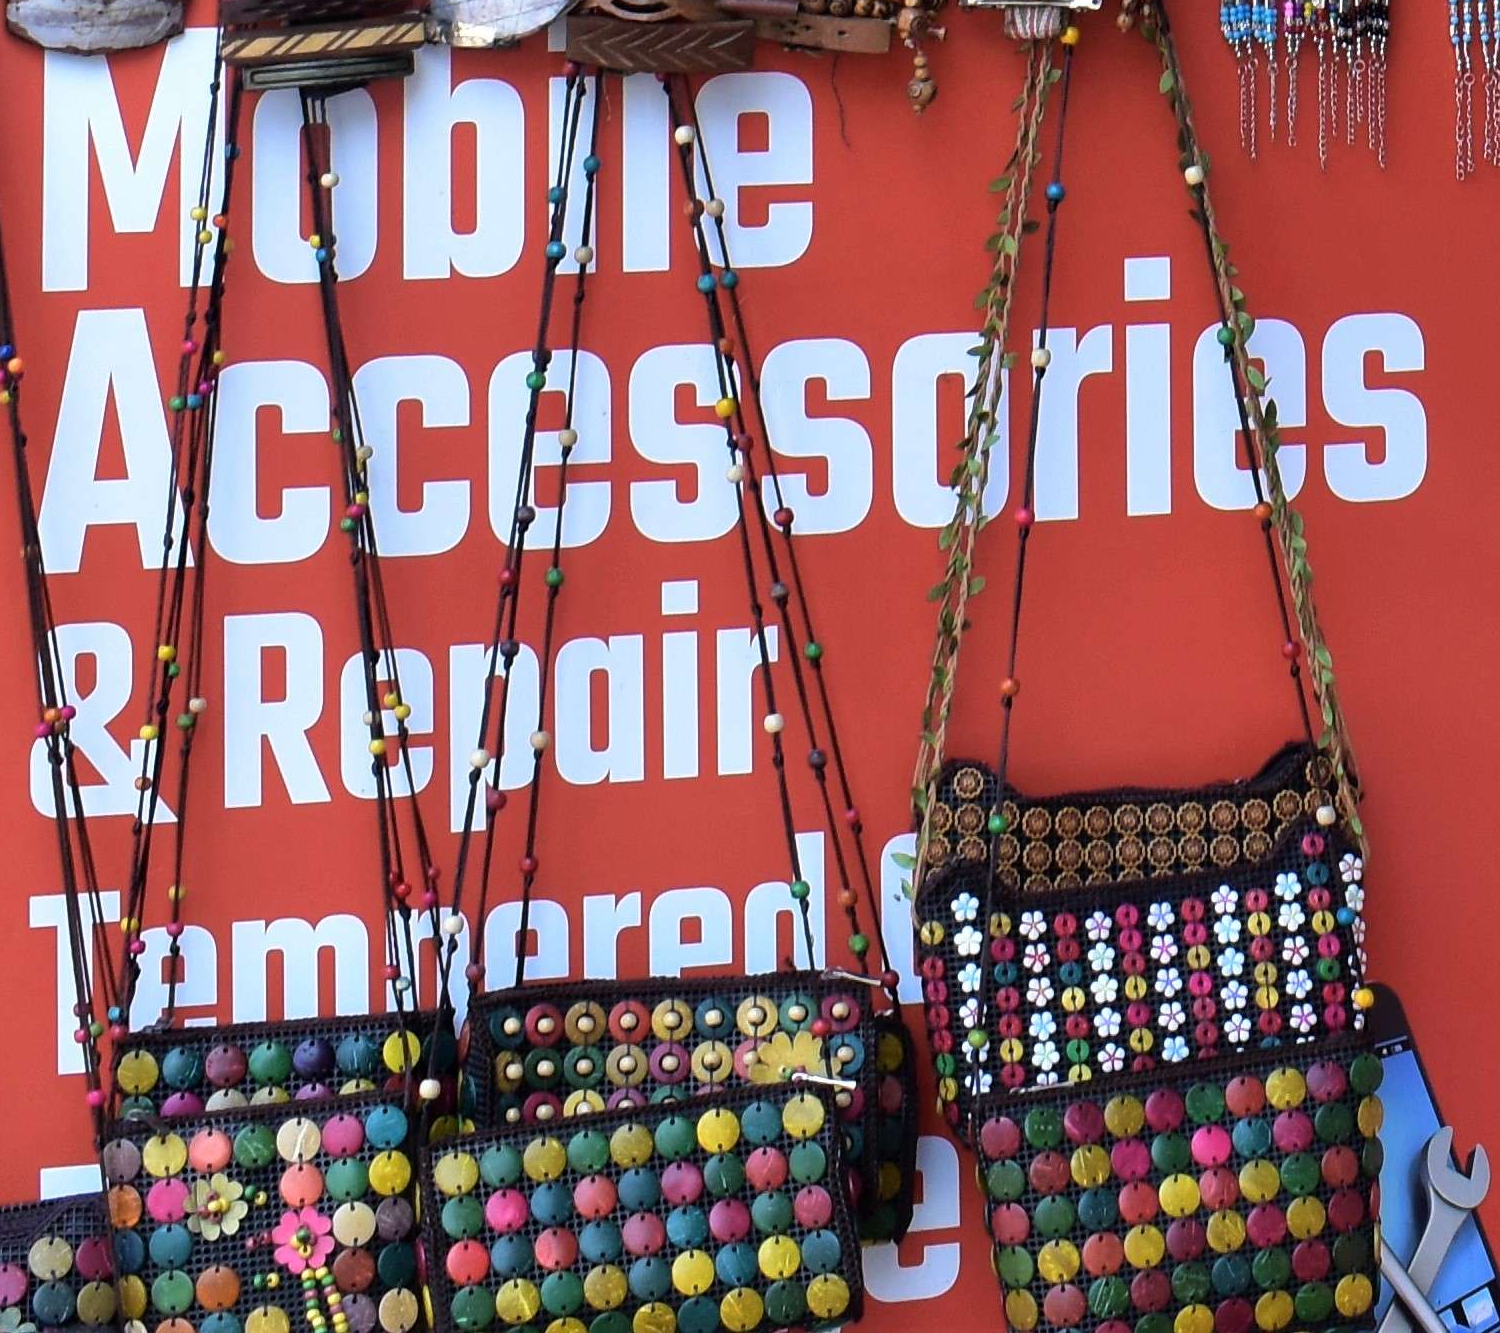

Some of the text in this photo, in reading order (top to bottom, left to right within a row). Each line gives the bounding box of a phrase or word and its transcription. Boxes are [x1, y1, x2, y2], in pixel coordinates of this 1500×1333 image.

[41, 27, 814, 292] Mobile
[38, 256, 1427, 573] Accessories
[29, 580, 780, 833] & Repair
